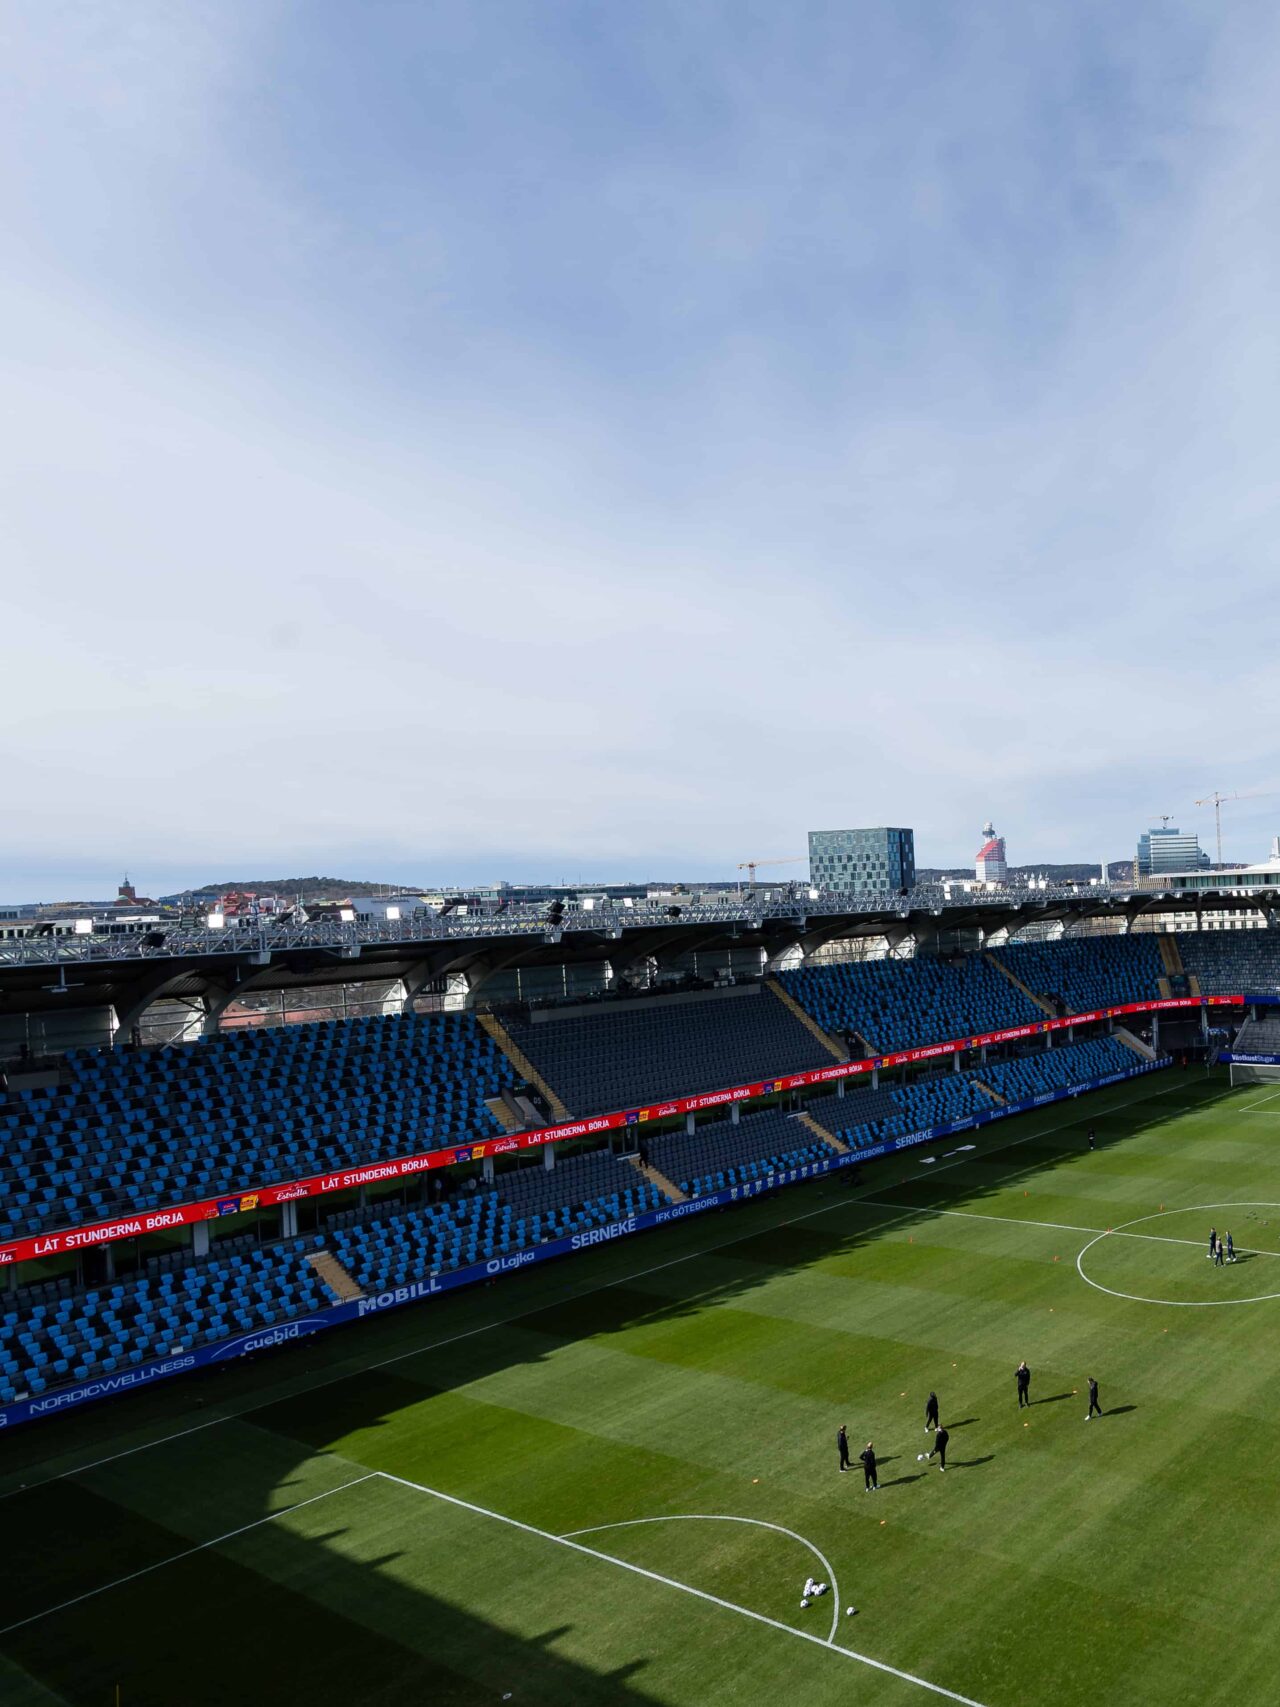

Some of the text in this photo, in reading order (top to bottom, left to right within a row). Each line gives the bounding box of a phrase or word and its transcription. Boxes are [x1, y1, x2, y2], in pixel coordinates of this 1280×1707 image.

[686, 1088, 751, 1110] LÅT STUNDERNA BÖRJA
[527, 1119, 610, 1145] LÅT STUNDERNA BÖRJA
[895, 1128, 933, 1149] SERNEKE
[838, 1145, 885, 1166] IFK GÖTEBORG
[321, 1158, 429, 1191] LÅT STUNDERNA BÖRJA
[276, 1188, 308, 1201] Estrella
[655, 1196, 719, 1223] IFK GÖTEBORG
[34, 1211, 184, 1255] LÅT STUNDERNA BÖRJA
[571, 1218, 637, 1250] SERNEKE
[501, 1251, 535, 1269] Lajka
[358, 1278, 442, 1317] MOBILL
[244, 1323, 299, 1351] cuebid
